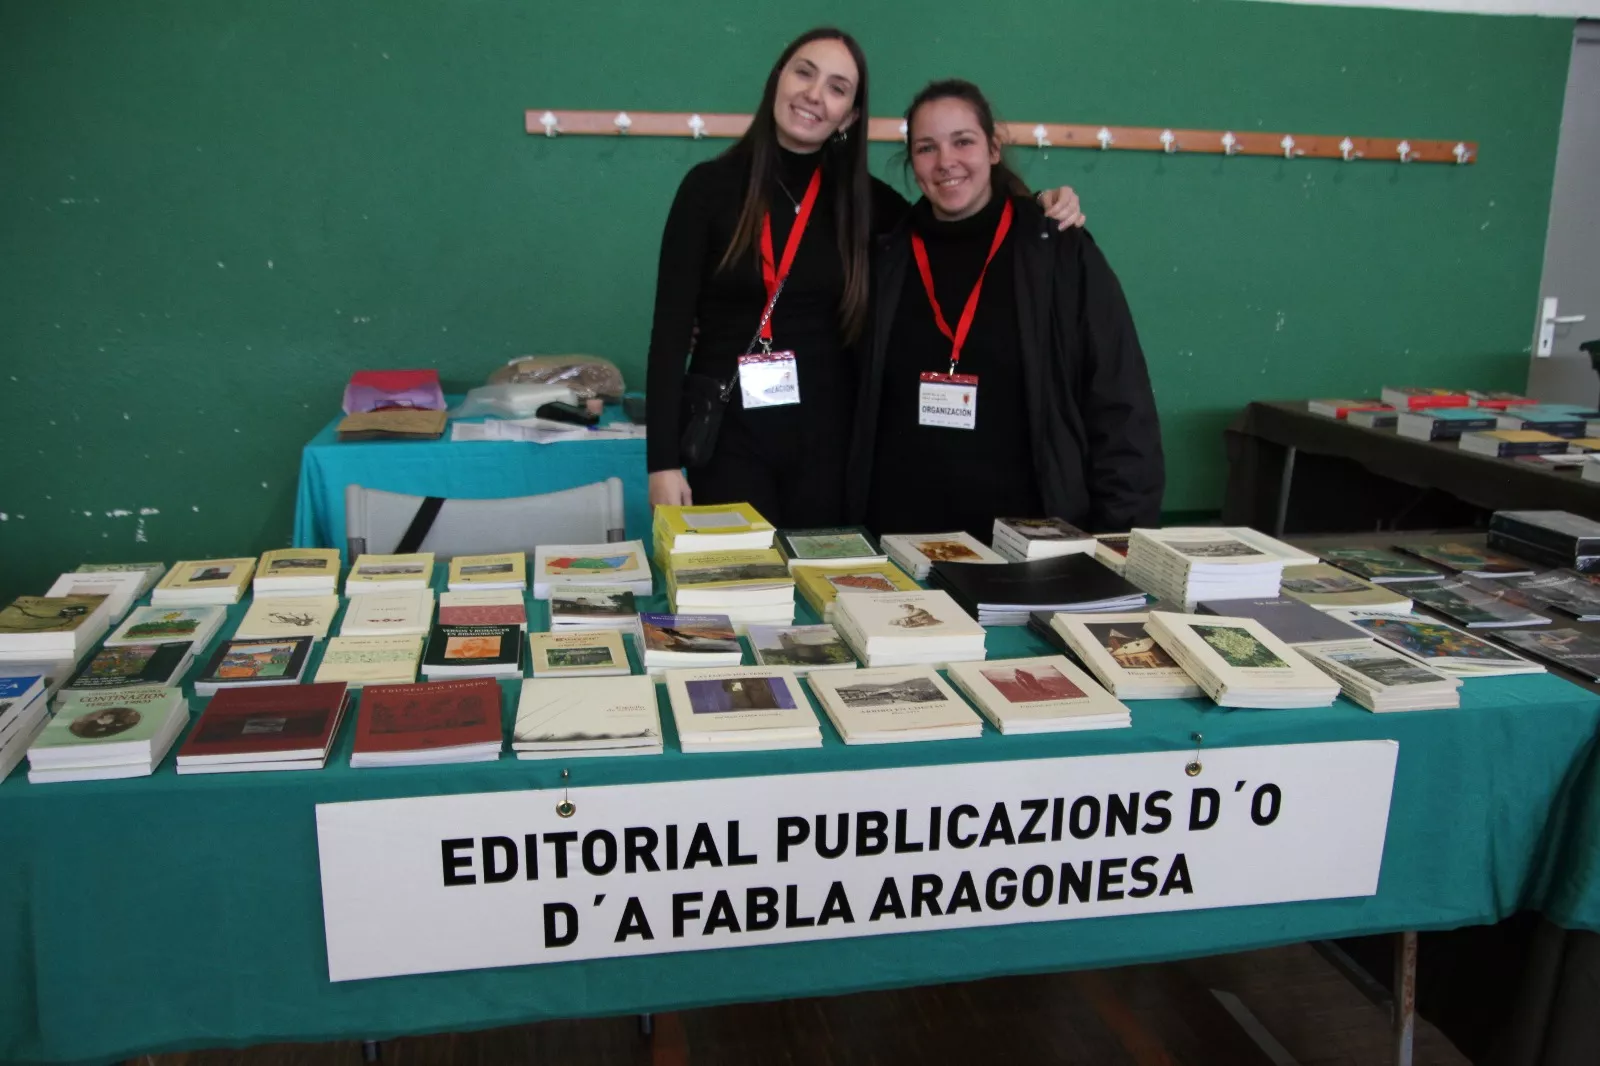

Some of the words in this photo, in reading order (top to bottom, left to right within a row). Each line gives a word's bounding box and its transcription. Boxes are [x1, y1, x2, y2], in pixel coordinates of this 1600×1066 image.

[922, 405, 972, 417] ORGANIZACIÓN
[442, 820, 757, 886] EDITORIAL
[777, 790, 1172, 862] PUBLICAZIONS
[673, 881, 849, 937] FABLA
[869, 854, 1193, 921] ARAGONESA
